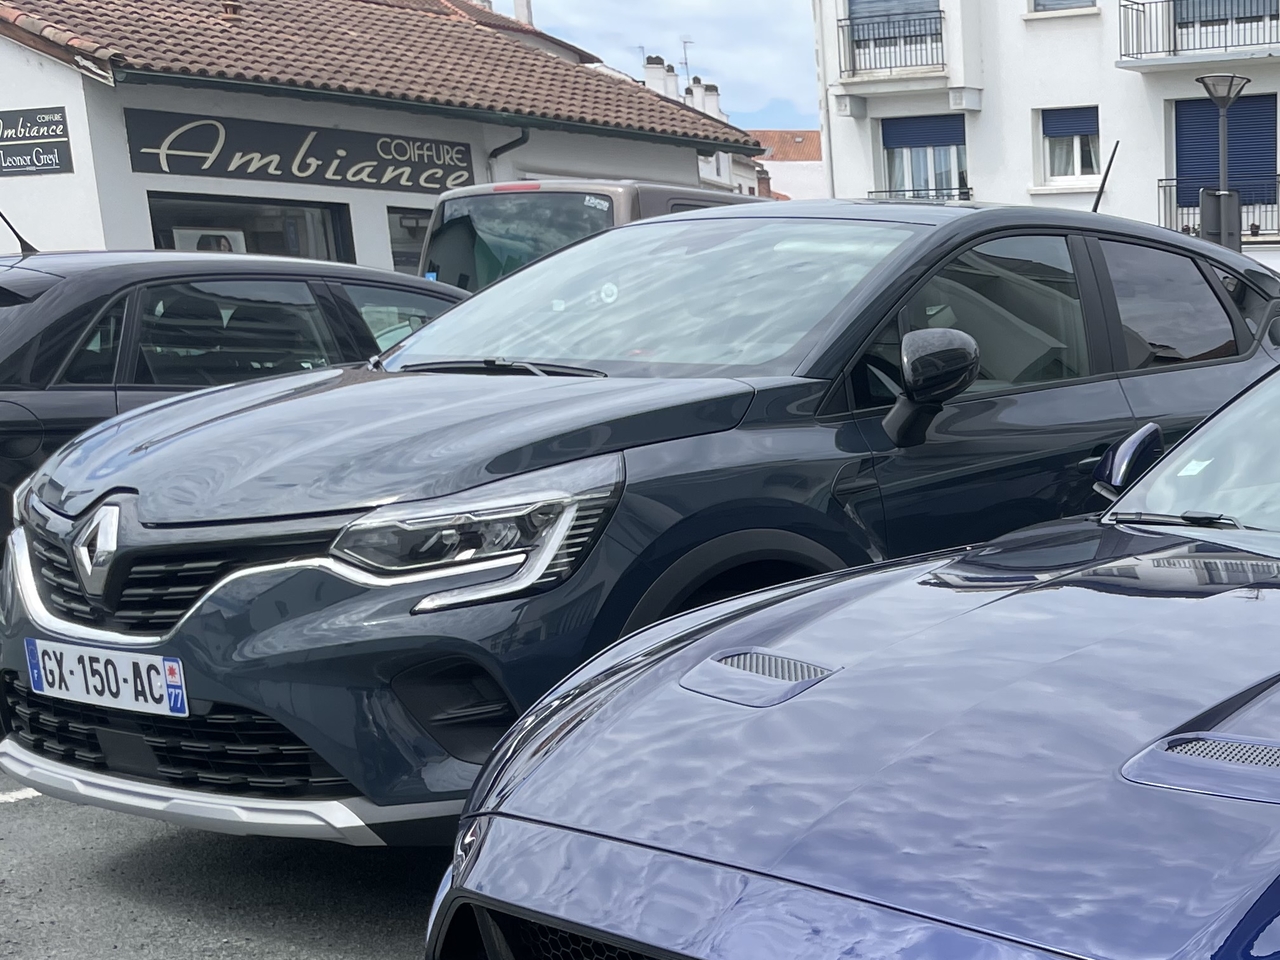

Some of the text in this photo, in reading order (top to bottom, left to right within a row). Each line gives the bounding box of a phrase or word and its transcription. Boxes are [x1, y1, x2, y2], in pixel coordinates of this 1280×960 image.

[0, 117, 64, 139] mbiance
[139, 119, 470, 189] Ambiance
[376, 137, 468, 168] COIFFURE
[41, 649, 164, 705] GX-150-AC
[168, 688, 182, 708] 77
